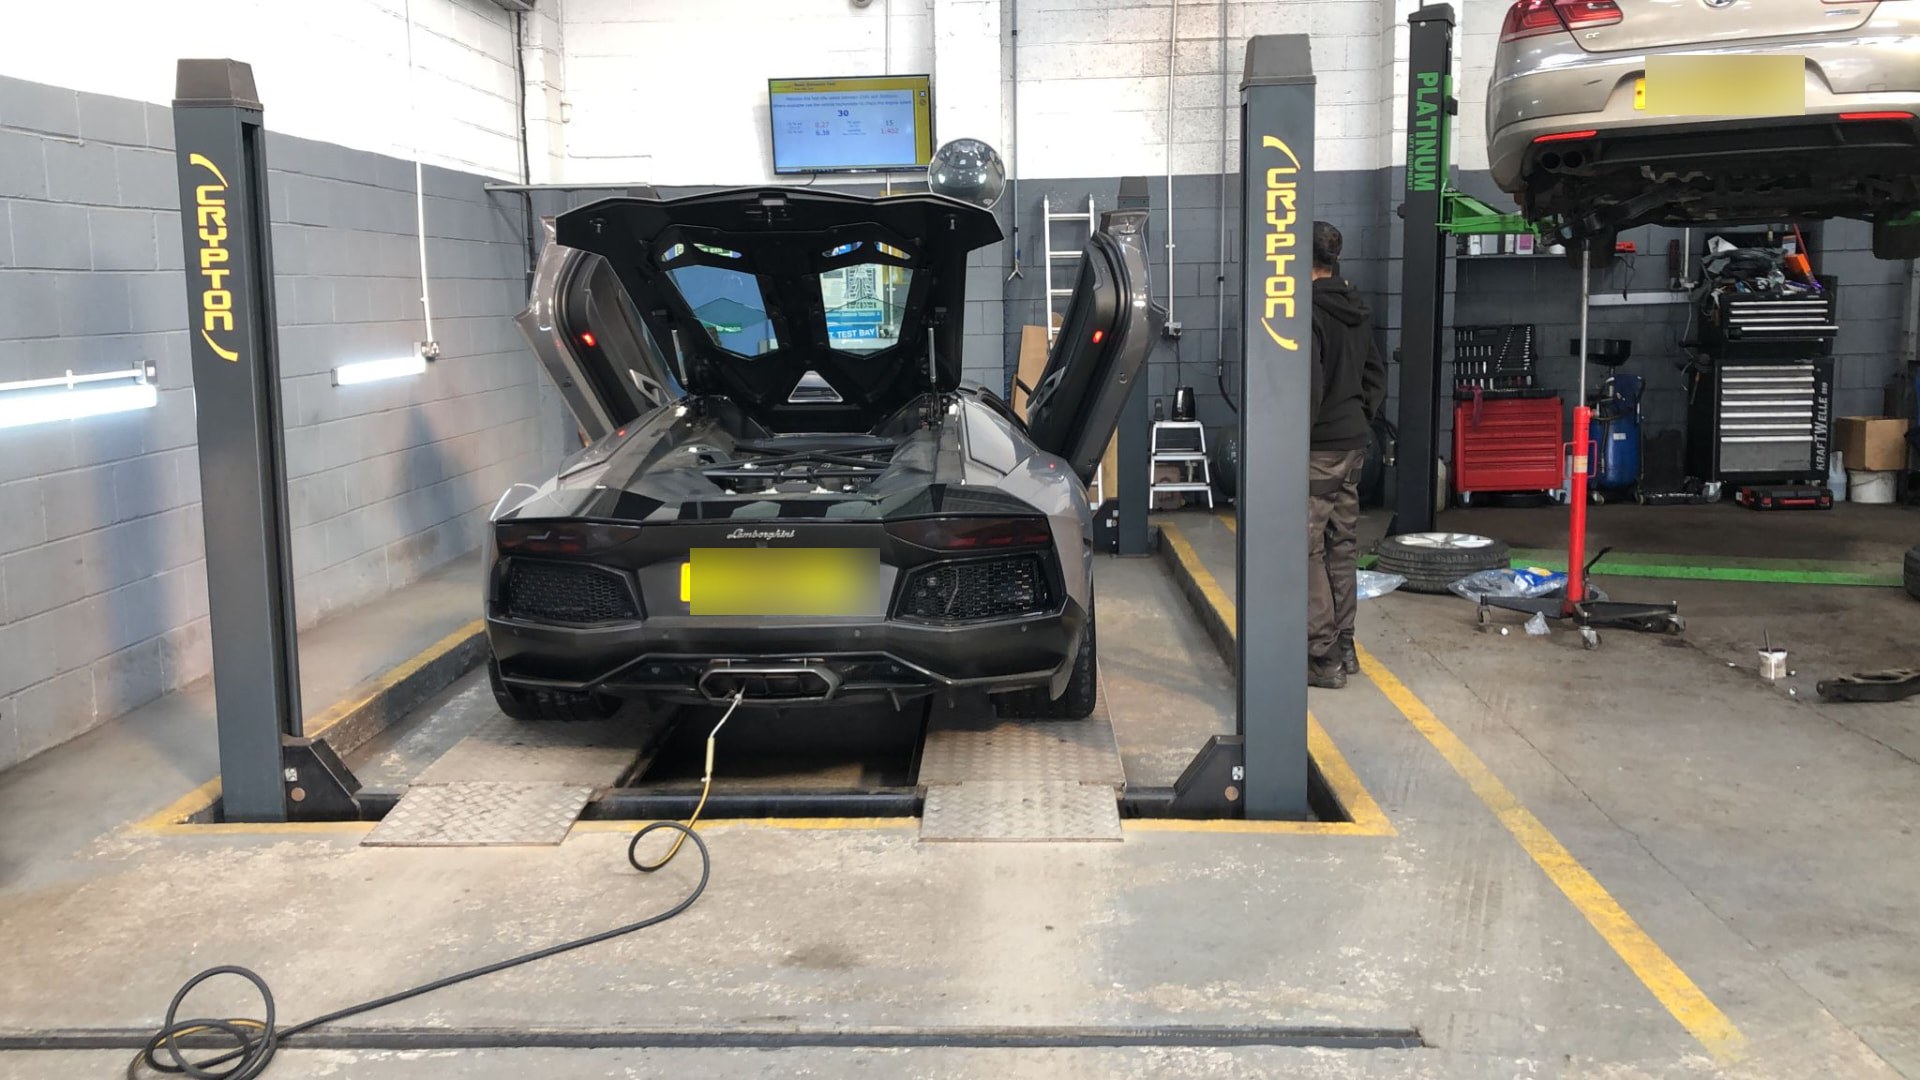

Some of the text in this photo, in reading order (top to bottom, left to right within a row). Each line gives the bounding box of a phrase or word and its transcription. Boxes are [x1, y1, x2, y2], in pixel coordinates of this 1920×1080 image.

[837, 109, 849, 117] 30
[1414, 72, 1439, 191] PLATINUM
[196, 185, 234, 331] CRYPTON
[1265, 167, 1297, 319] CRYPTON
[837, 329, 857, 338] TEST
[858, 328, 875, 337] BAY
[726, 528, 795, 541] Lamborghini
